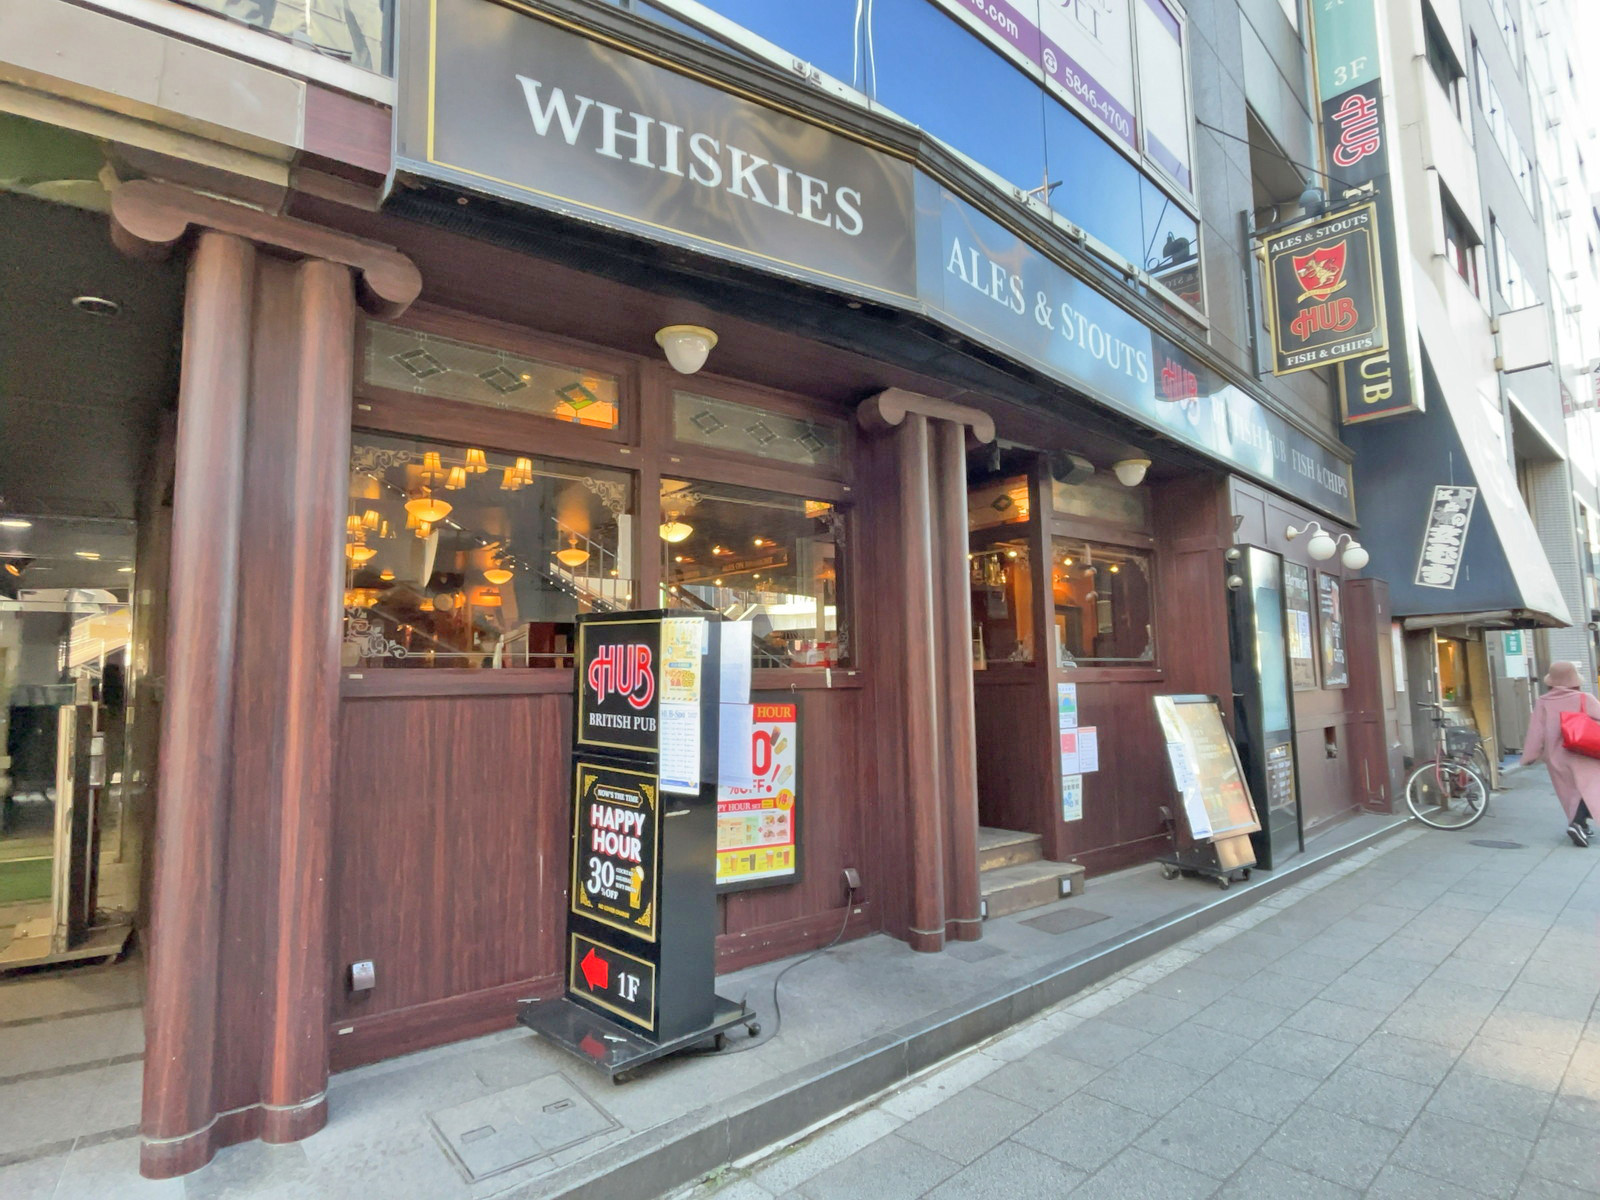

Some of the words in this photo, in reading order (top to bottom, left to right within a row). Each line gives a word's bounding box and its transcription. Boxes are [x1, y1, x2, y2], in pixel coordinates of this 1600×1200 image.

[1333, 55, 1367, 86] 3F
[1065, 66, 1130, 138] 5846-4700
[1331, 93, 1381, 167] HUB
[515, 73, 865, 237] WHISKIES
[1270, 235, 1302, 254] ALES
[1304, 232, 1314, 242] &
[1316, 212, 1369, 239] STOUTS
[946, 236, 1026, 316] ALES
[1035, 290, 1055, 331] &
[1061, 301, 1149, 384] STOUTS
[1290, 296, 1359, 342] HUB
[1286, 349, 1317, 367] FISH
[1319, 348, 1328, 359] &
[1330, 336, 1373, 355] CHIPS
[1360, 351, 1394, 405] UB
[1291, 448, 1316, 481] FISH
[1316, 462, 1323, 483] &
[1322, 466, 1348, 499] CHIPS
[588, 643, 656, 711] HUB
[589, 711, 632, 730] BRITISH
[633, 715, 657, 732] PUB
[756, 706, 792, 718] HOUR
[591, 803, 646, 838] HAPPY
[728, 802, 751, 812] HOUR
[592, 828, 642, 862] HOUR
[587, 856, 615, 894] 30
[601, 886, 619, 900] %OFF
[617, 971, 640, 1003] 1F
